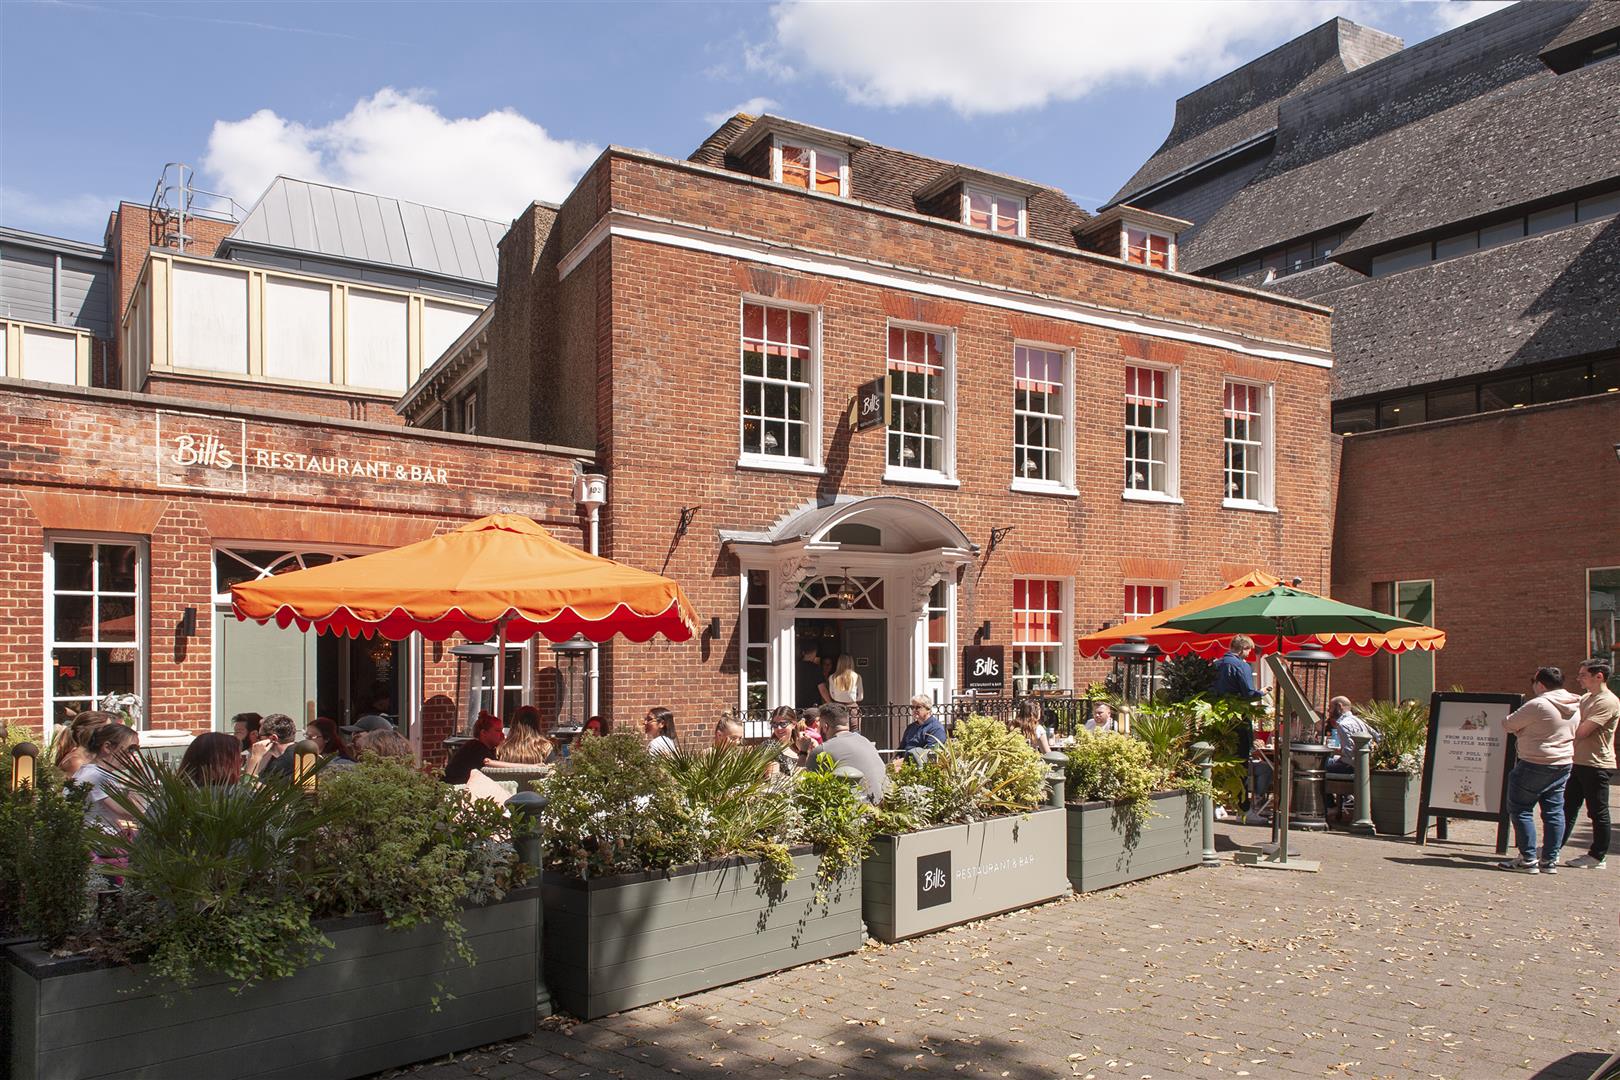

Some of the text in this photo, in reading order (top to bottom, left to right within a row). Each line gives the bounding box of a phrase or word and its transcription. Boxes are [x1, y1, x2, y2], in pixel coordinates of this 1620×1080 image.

[171, 435, 233, 468] Bill's
[256, 448, 448, 484] RESTAURANT & BAR
[973, 657, 999, 676] Bill's
[922, 867, 946, 892] Bill's
[956, 859, 1010, 880] RESTAURANT
[1019, 855, 1035, 867] BAR
